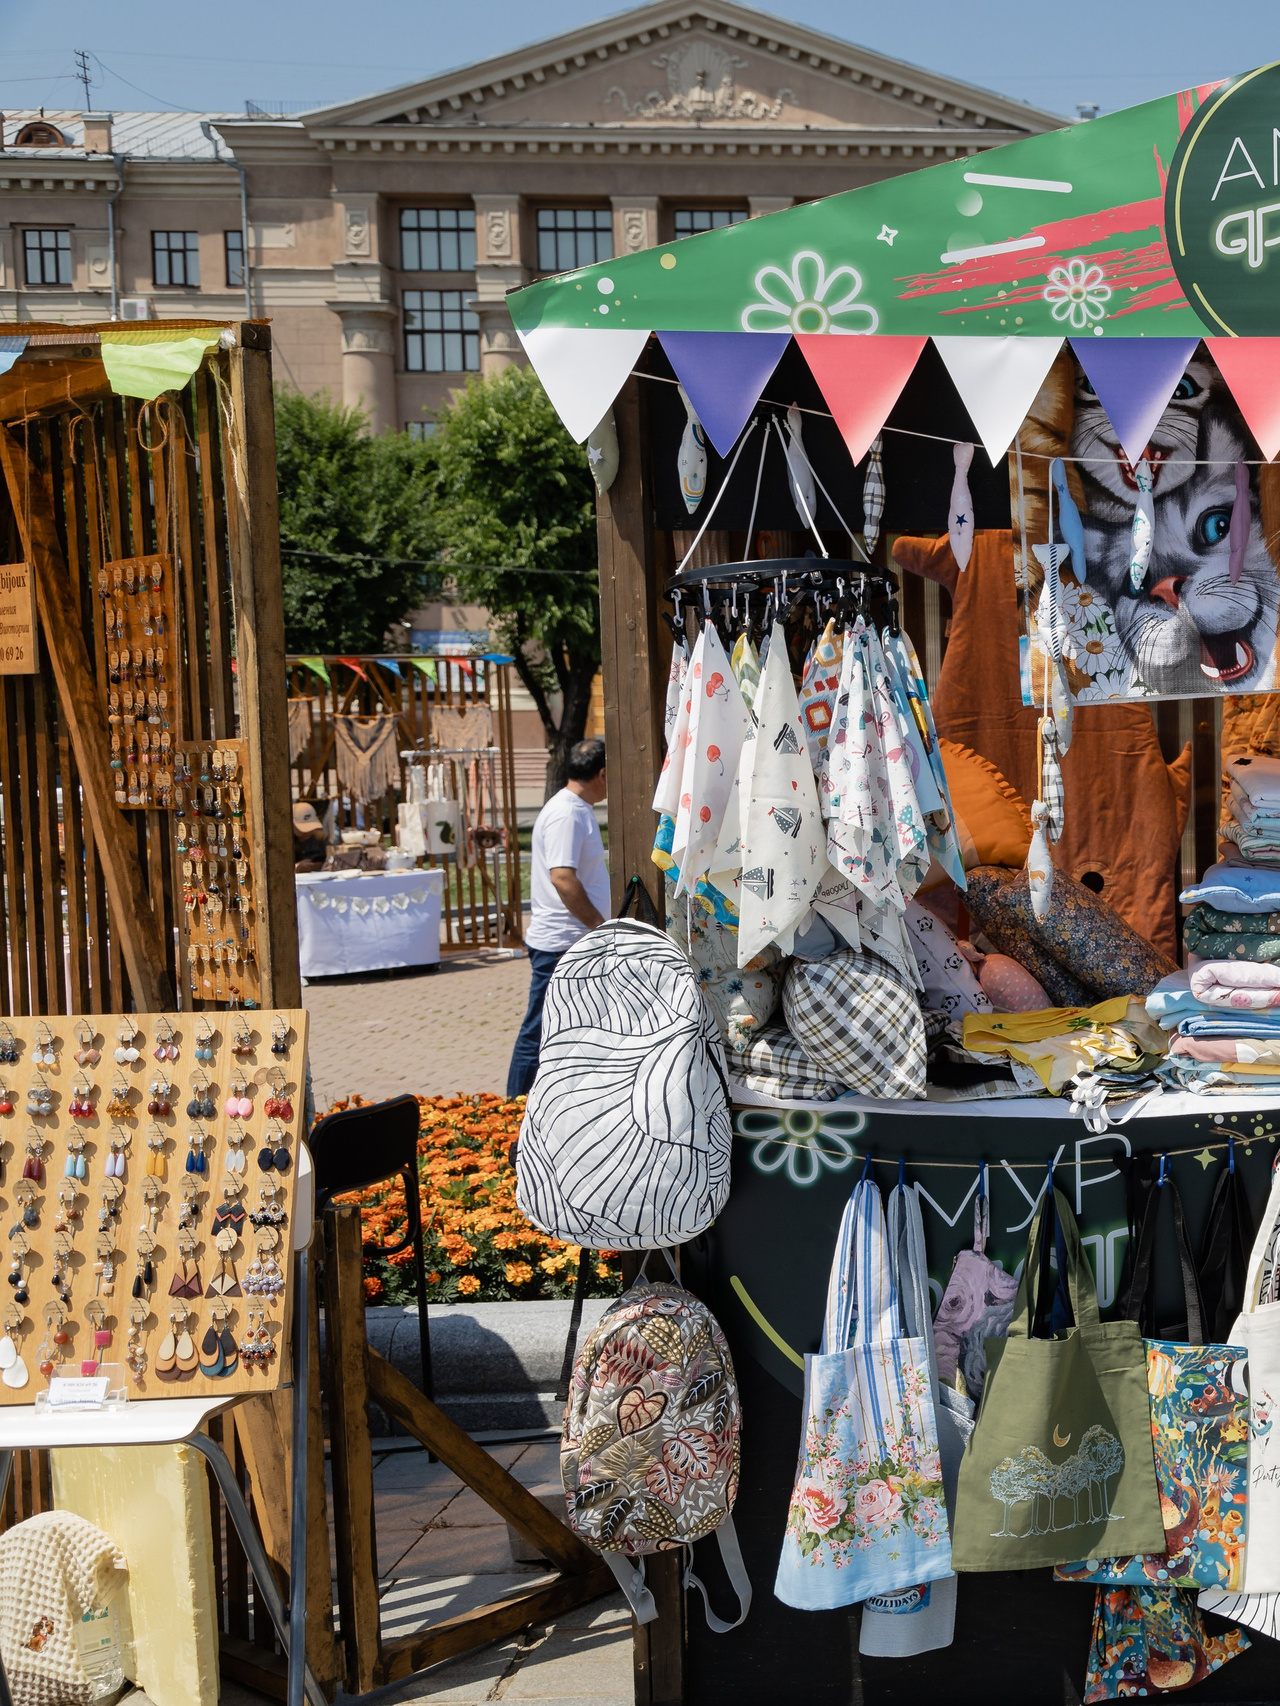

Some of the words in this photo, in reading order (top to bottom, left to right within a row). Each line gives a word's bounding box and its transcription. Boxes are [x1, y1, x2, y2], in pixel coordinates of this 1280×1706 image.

[0, 572, 26, 593] bijoux
[6, 646, 14, 660] 69
[16, 646, 24, 660] 26
[821, 879, 849, 898] Любовь
[914, 1133, 1132, 1238] МУР
[868, 1591, 919, 1608] HOLIDAYS
